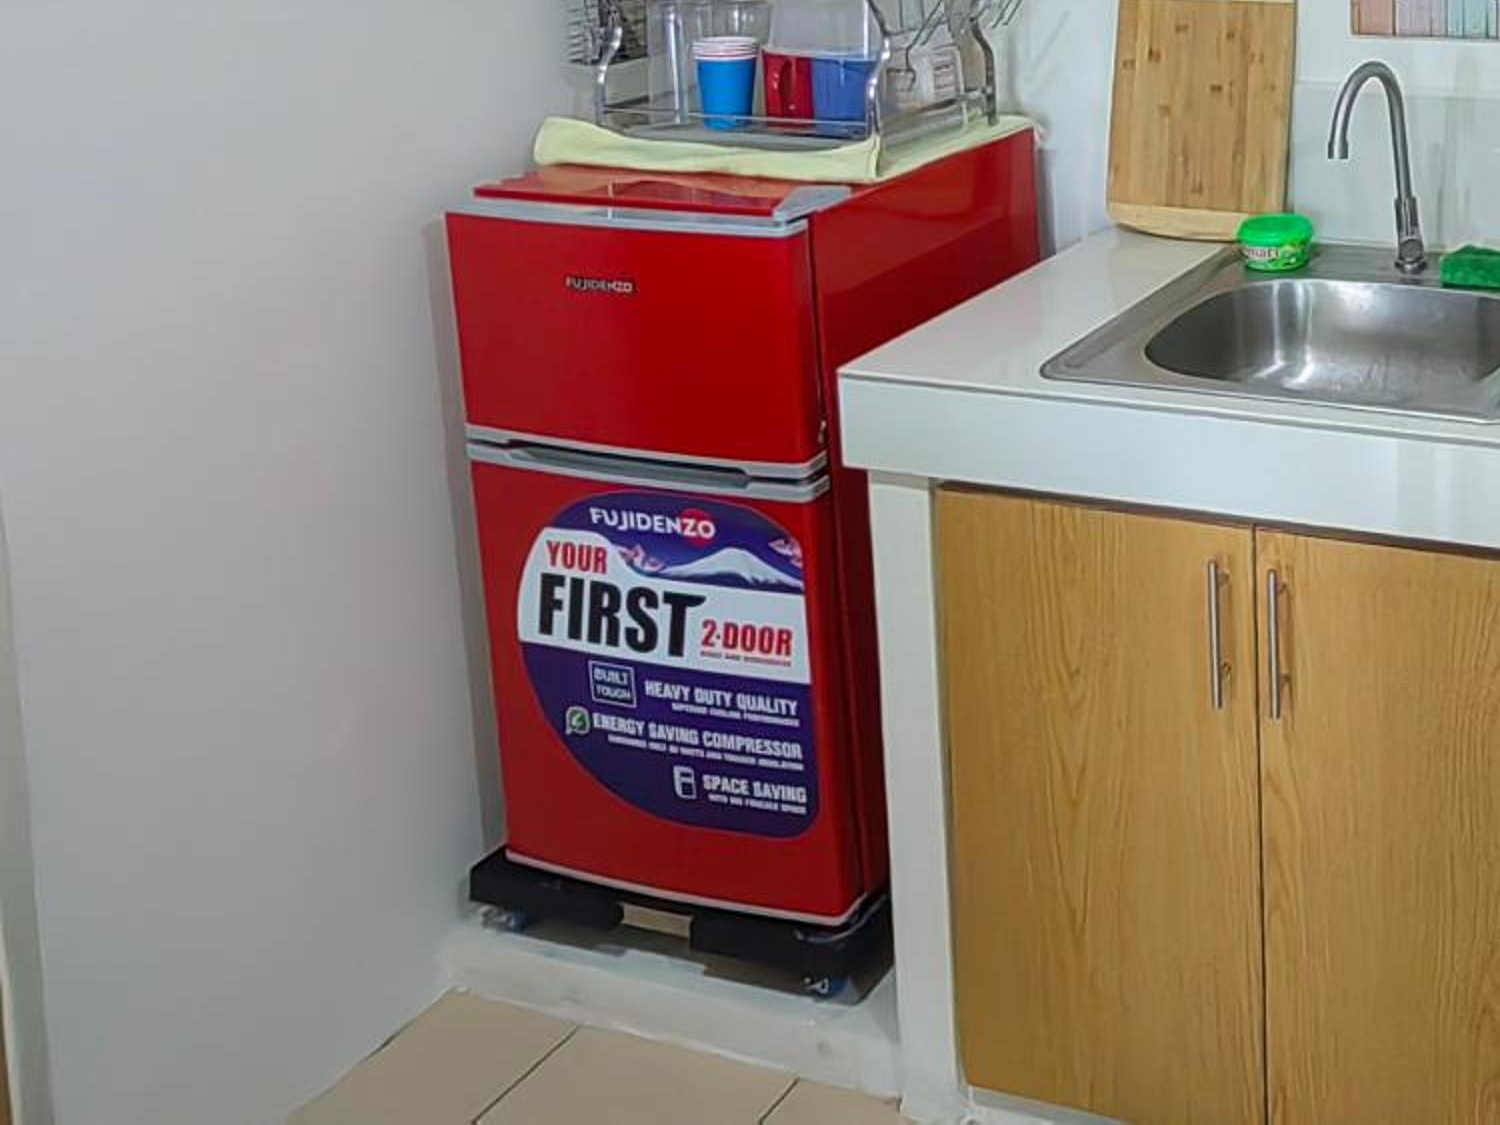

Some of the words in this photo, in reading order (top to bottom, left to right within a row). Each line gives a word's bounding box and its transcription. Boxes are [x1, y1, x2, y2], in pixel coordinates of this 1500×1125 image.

[589, 507, 717, 539] FUJIDENZO
[546, 540, 609, 574] YOUR
[538, 573, 706, 658] FIRST
[594, 668, 630, 685] BUILT
[644, 680, 690, 702] HEAVY
[693, 687, 732, 708] DUTY
[736, 692, 798, 716] QUALITY
[592, 712, 645, 737] ENERGY
[648, 722, 699, 745] SAVING
[702, 731, 803, 760] COMPRESSOR
[703, 775, 749, 796] SPACE
[753, 782, 807, 804] SAVING
